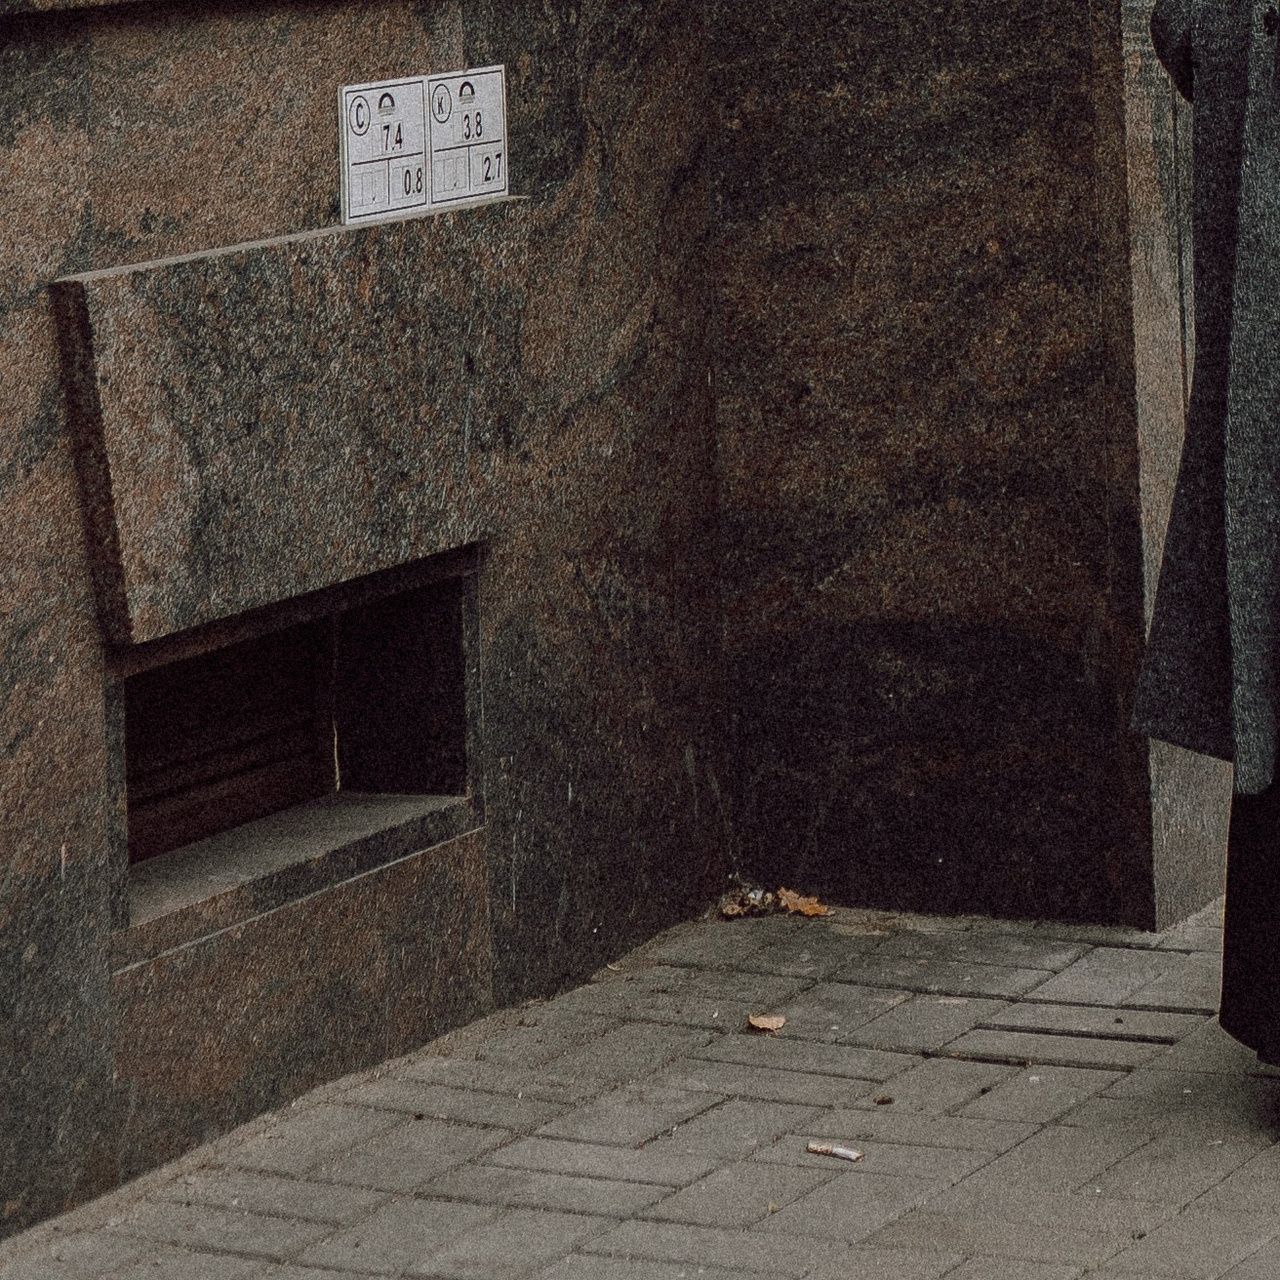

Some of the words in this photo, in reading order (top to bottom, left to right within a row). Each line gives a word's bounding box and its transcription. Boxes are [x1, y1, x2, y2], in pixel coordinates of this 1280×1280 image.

[382, 123, 403, 151] 7.4
[463, 111, 483, 141] 3.8
[404, 167, 423, 196] 0.8
[484, 152, 502, 182] 2.7
